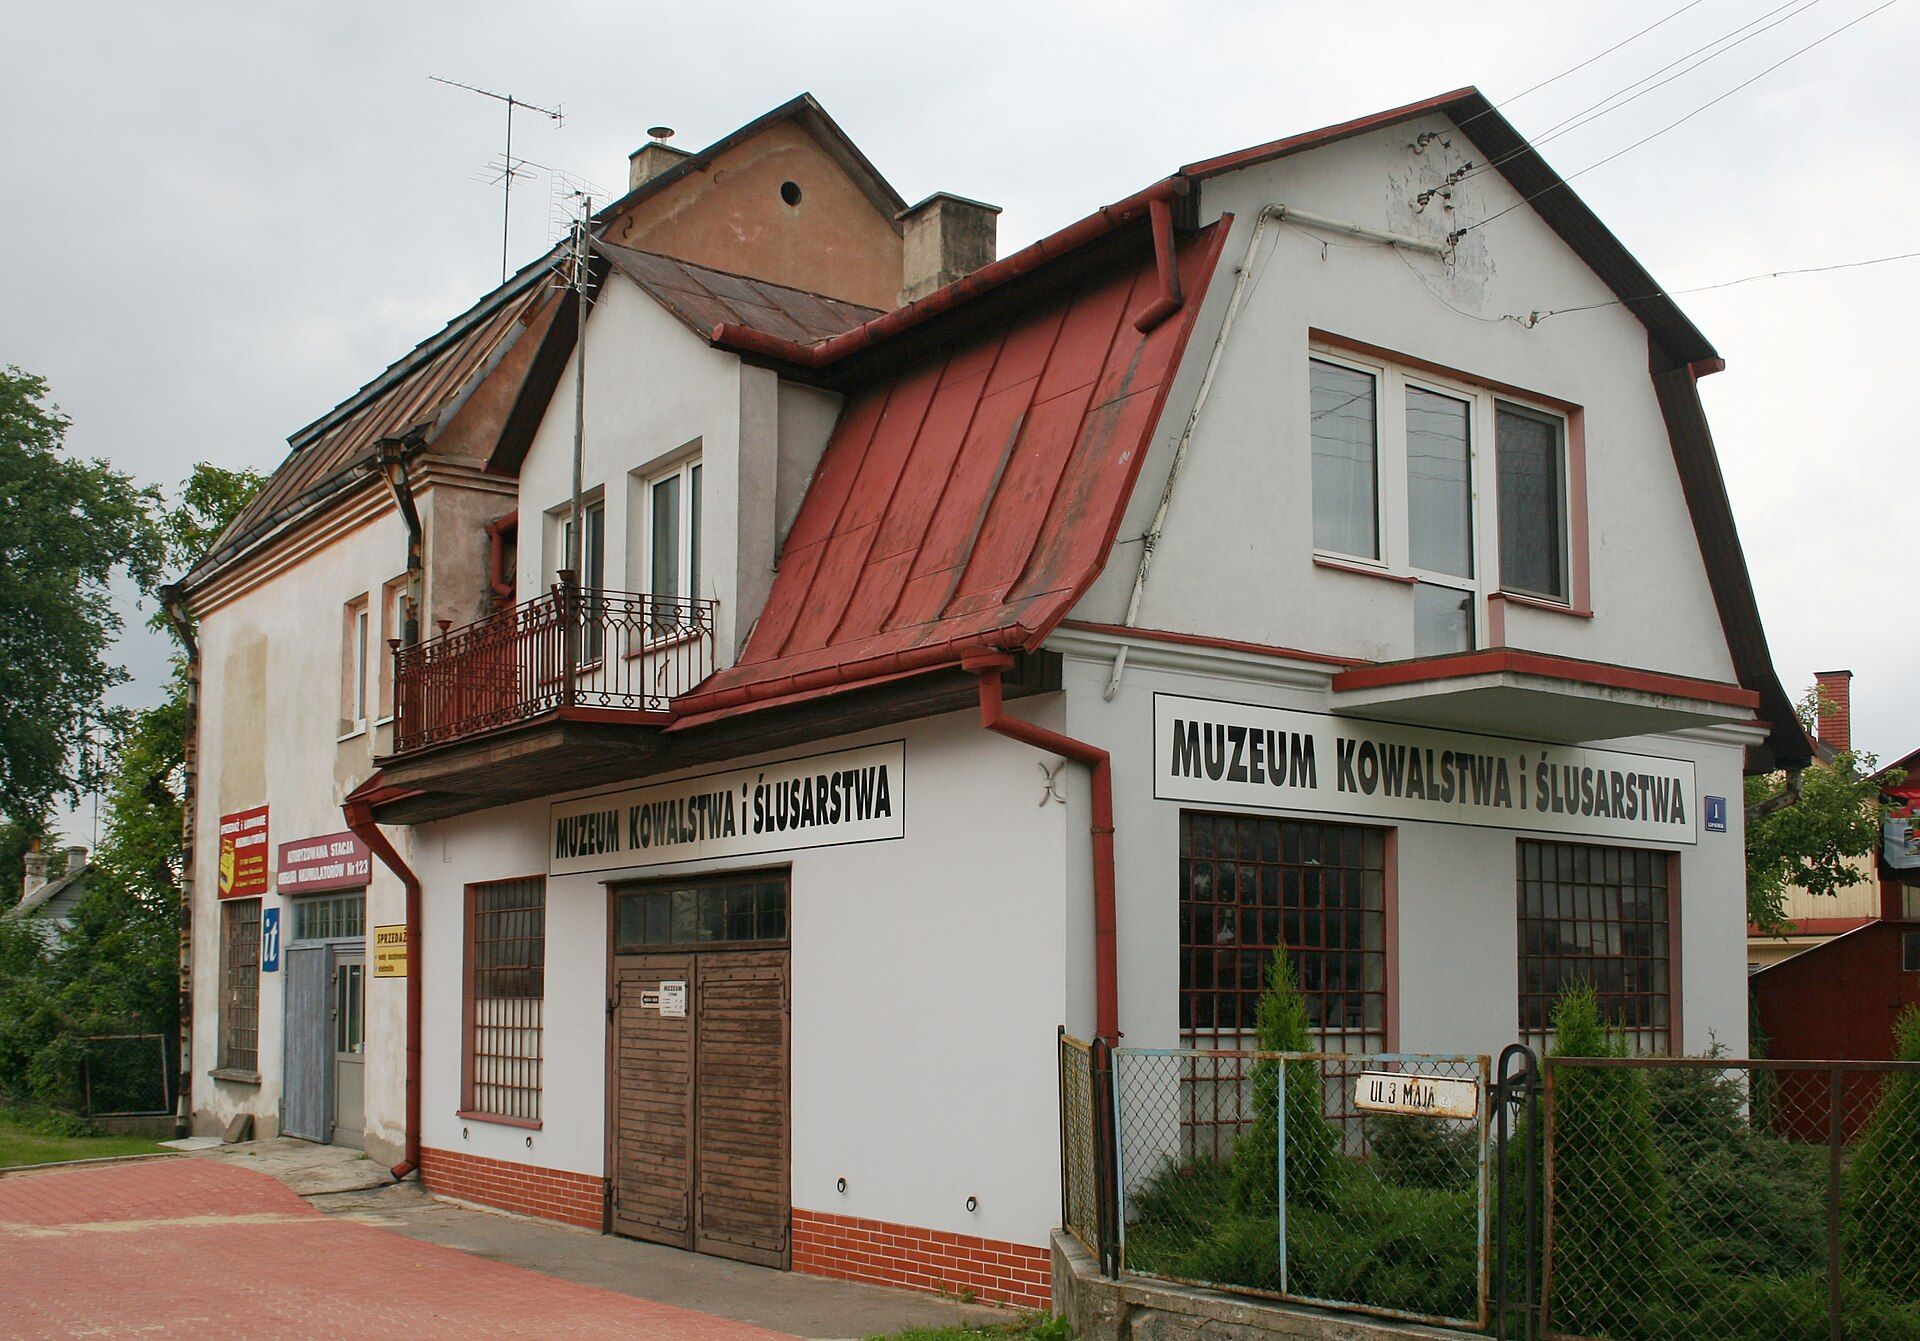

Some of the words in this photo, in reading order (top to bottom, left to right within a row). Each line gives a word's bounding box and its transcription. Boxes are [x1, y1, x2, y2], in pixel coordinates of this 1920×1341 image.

[1171, 719, 1317, 789] MUZEUM
[1336, 738, 1511, 808] KOWALSTWA
[1520, 756, 1527, 810] i
[1536, 751, 1686, 824] ŚLUSARSTWA
[556, 809, 620, 859] MUZEUM
[629, 790, 736, 850] KOWALSTWA
[742, 782, 747, 835] i
[753, 765, 891, 835] ŚLUSARSTWA
[330, 840, 354, 856] STACJA
[355, 859, 368, 875] 123
[264, 918, 278, 962] it
[377, 928, 407, 944] SPRZEDAŻ
[1403, 1083, 1435, 1108] MAJA
